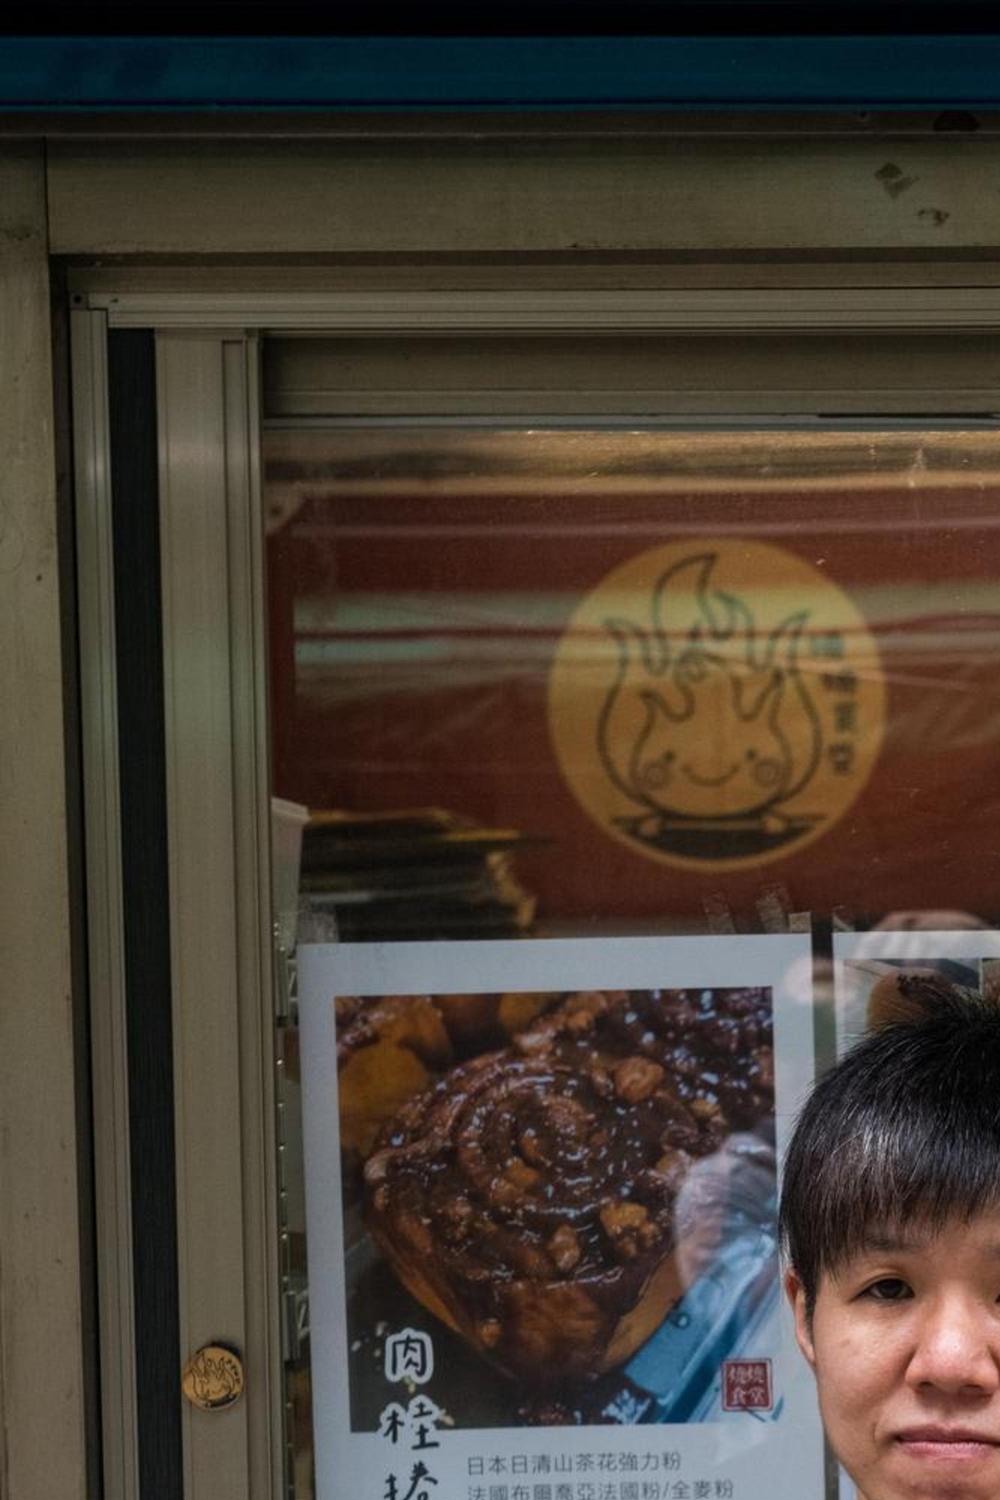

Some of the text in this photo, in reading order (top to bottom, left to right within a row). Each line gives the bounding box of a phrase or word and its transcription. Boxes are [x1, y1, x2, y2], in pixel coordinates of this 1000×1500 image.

[467, 1451, 682, 1477] 日本日清山茶花強力粉
